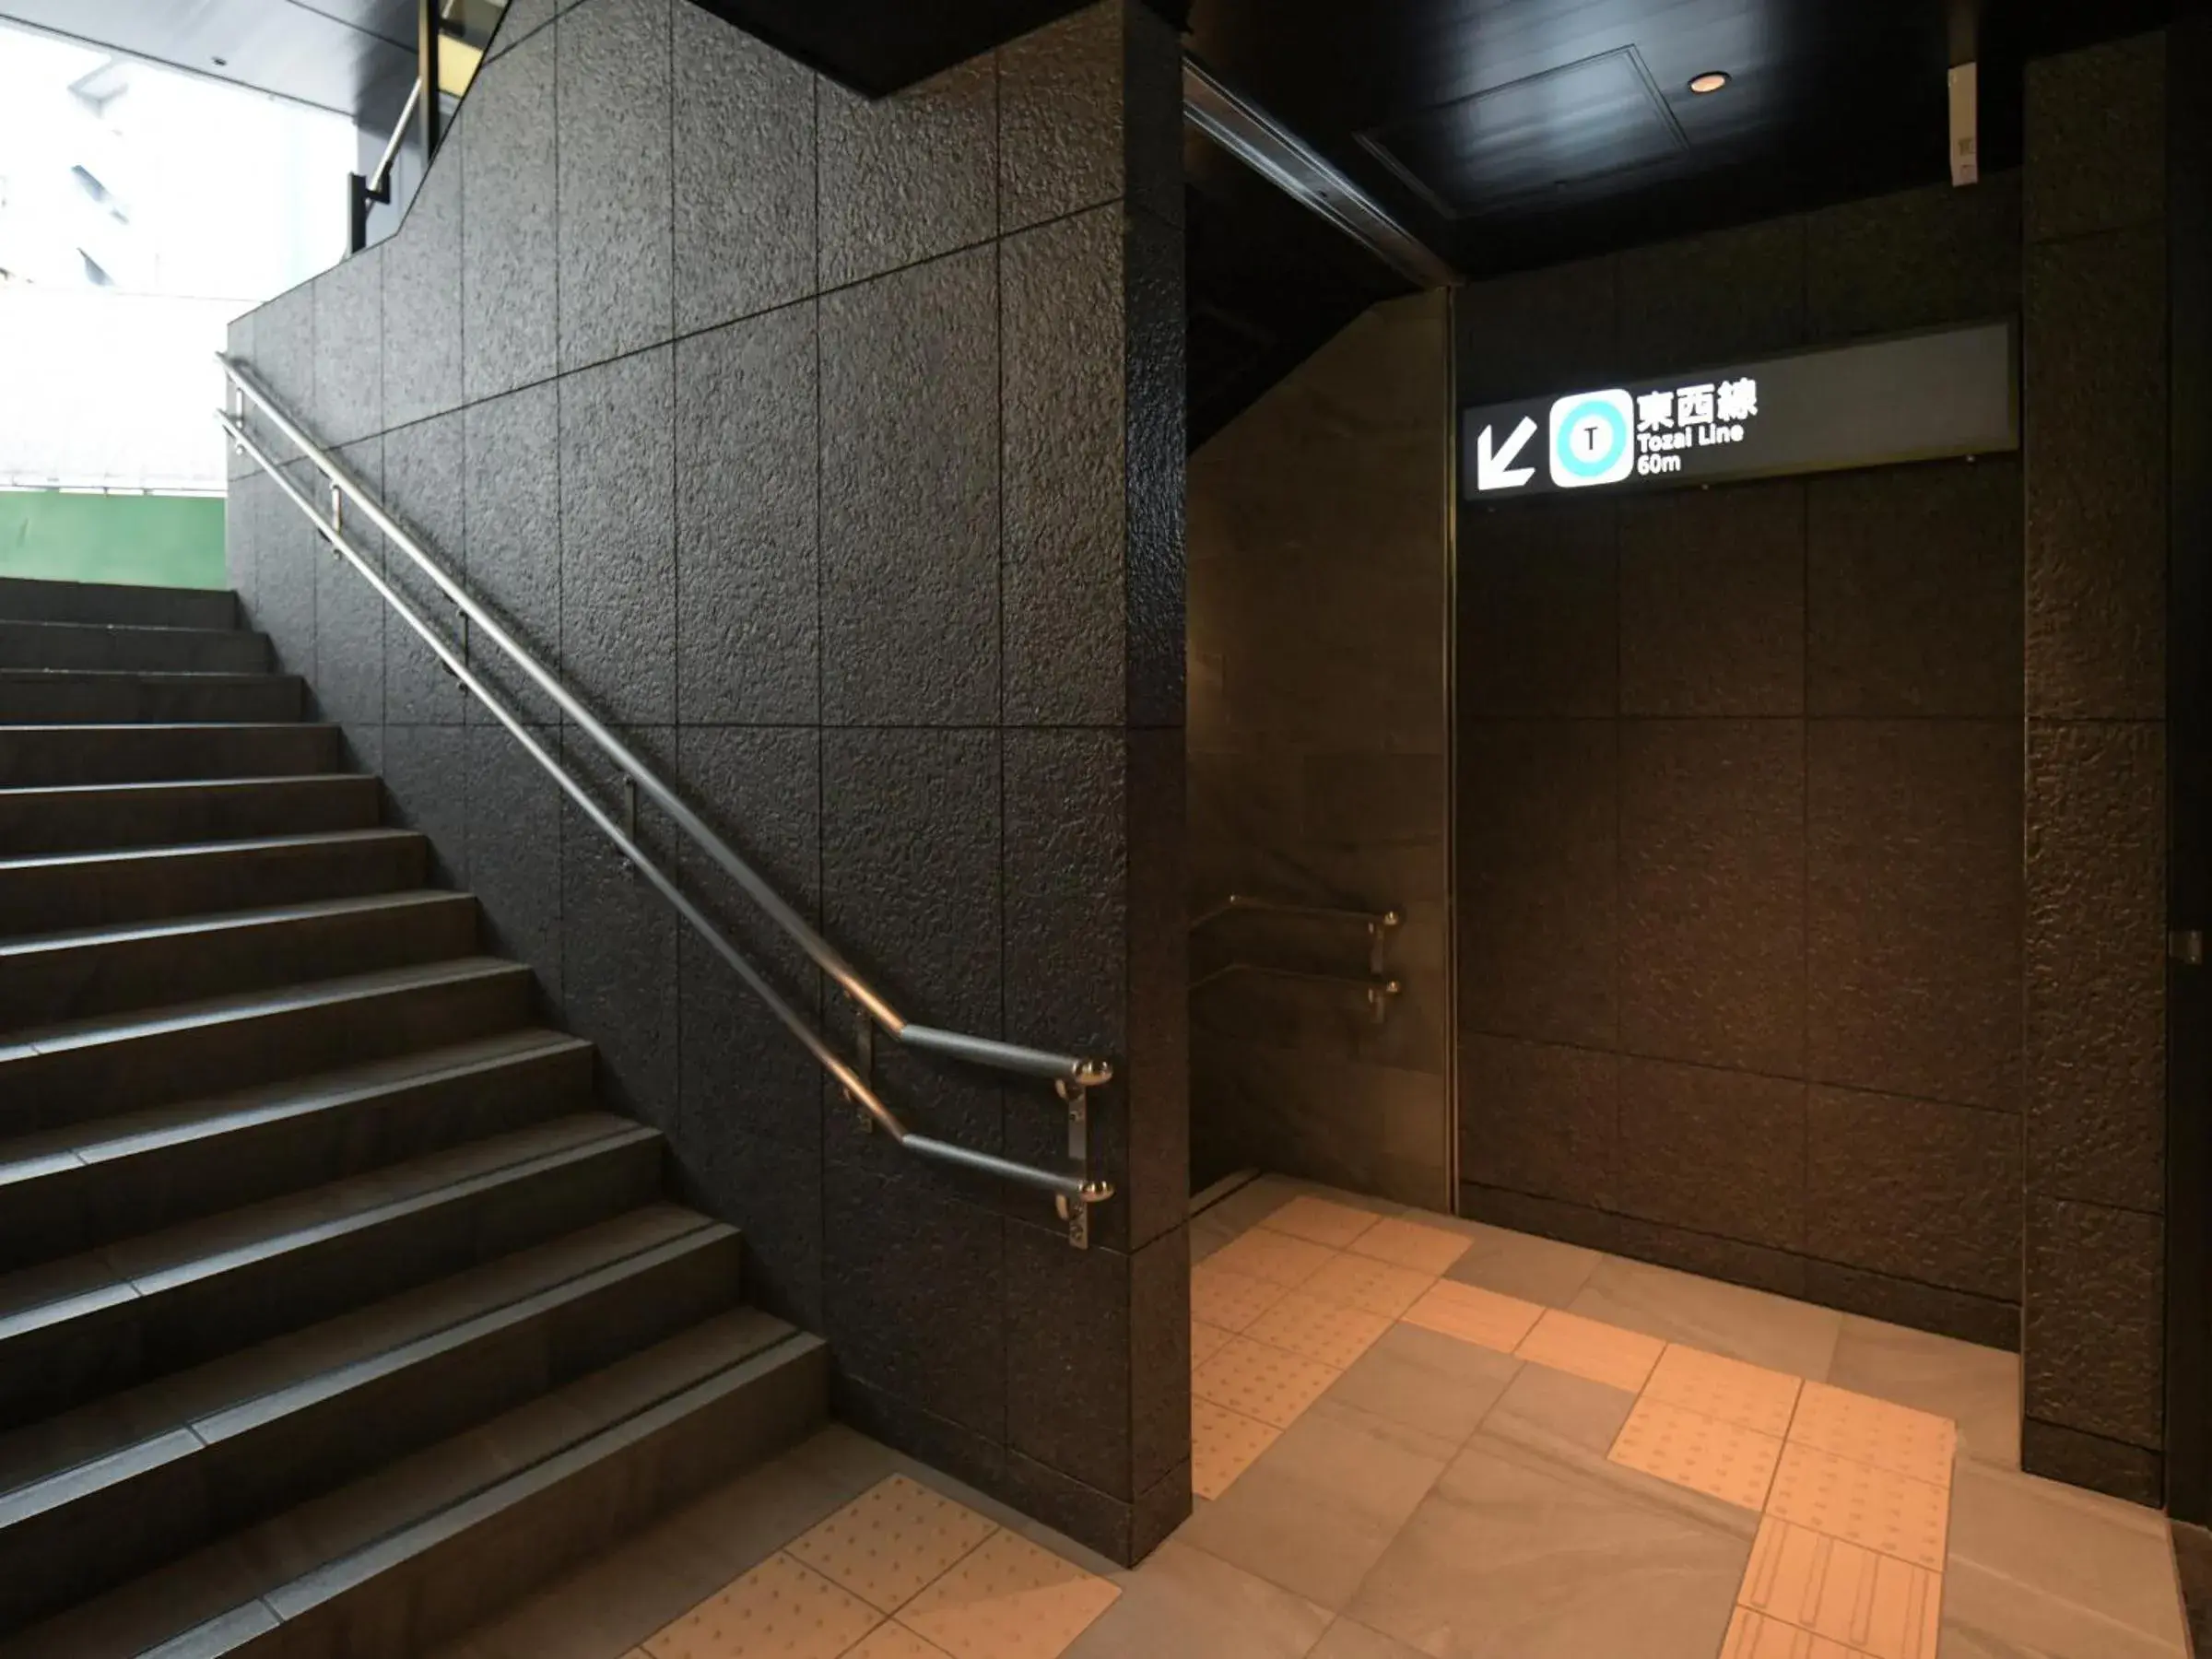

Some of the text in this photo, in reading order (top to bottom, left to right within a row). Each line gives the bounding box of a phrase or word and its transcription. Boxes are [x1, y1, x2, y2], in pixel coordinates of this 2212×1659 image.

[1636, 378, 1758, 430] 東西線
[1583, 427, 1598, 451] T
[1636, 423, 1745, 453] Tozai Line
[1637, 453, 1681, 476] 60m
